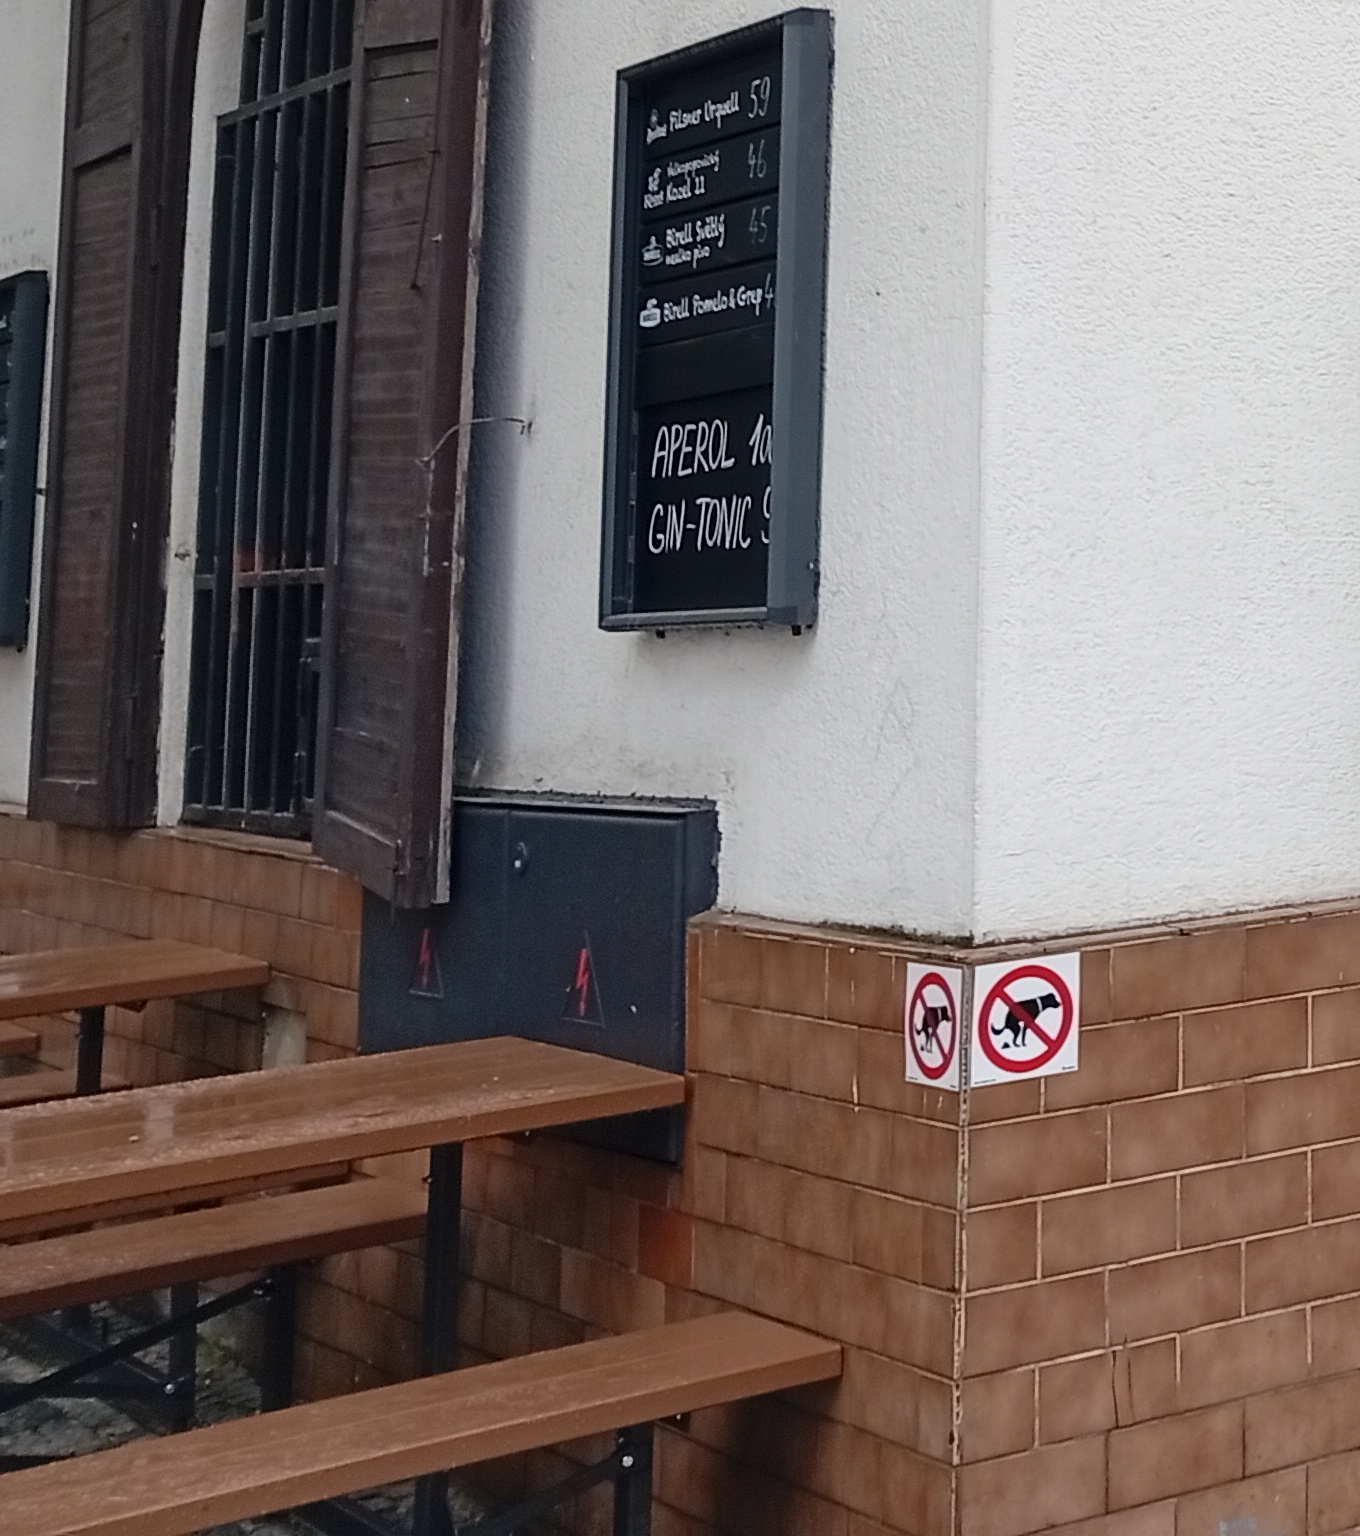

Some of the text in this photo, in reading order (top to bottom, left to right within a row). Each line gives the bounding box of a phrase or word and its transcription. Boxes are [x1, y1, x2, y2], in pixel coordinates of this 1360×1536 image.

[669, 76, 771, 132] Pilsner Urquell 59
[748, 139, 767, 178] 46
[666, 175, 706, 204] Kozel 11
[665, 222, 693, 249] Birell
[749, 206, 771, 244] 45
[663, 296, 690, 323] Birell
[651, 418, 736, 479] APEROL
[649, 494, 752, 554] GIN-TONIC
